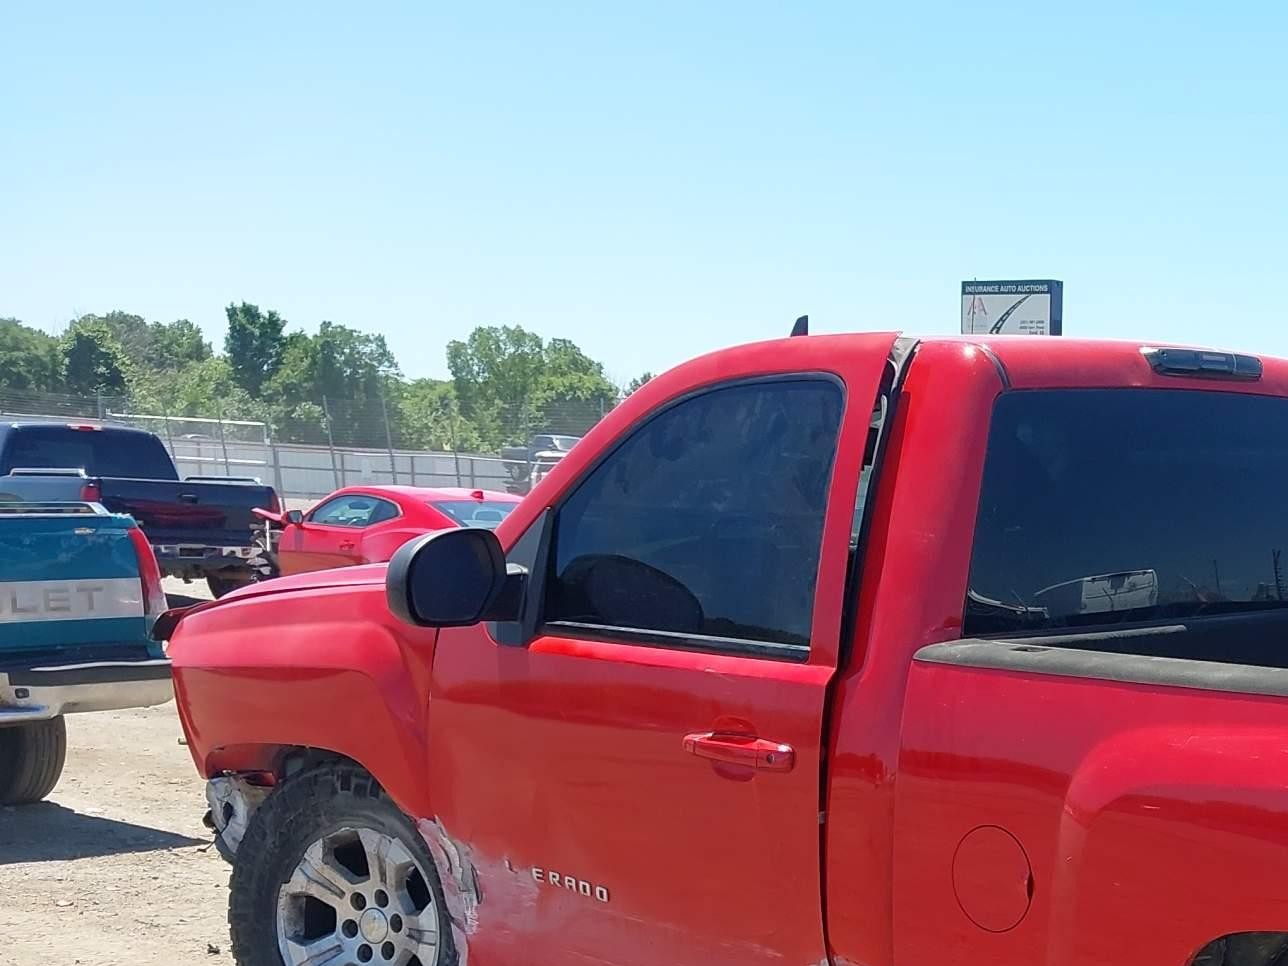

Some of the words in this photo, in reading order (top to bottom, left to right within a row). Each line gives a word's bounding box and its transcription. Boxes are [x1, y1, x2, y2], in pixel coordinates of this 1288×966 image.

[965, 285, 999, 293] INSURANCE
[1017, 284, 1049, 292] AUCTIONS
[531, 866, 610, 903] ERADO
